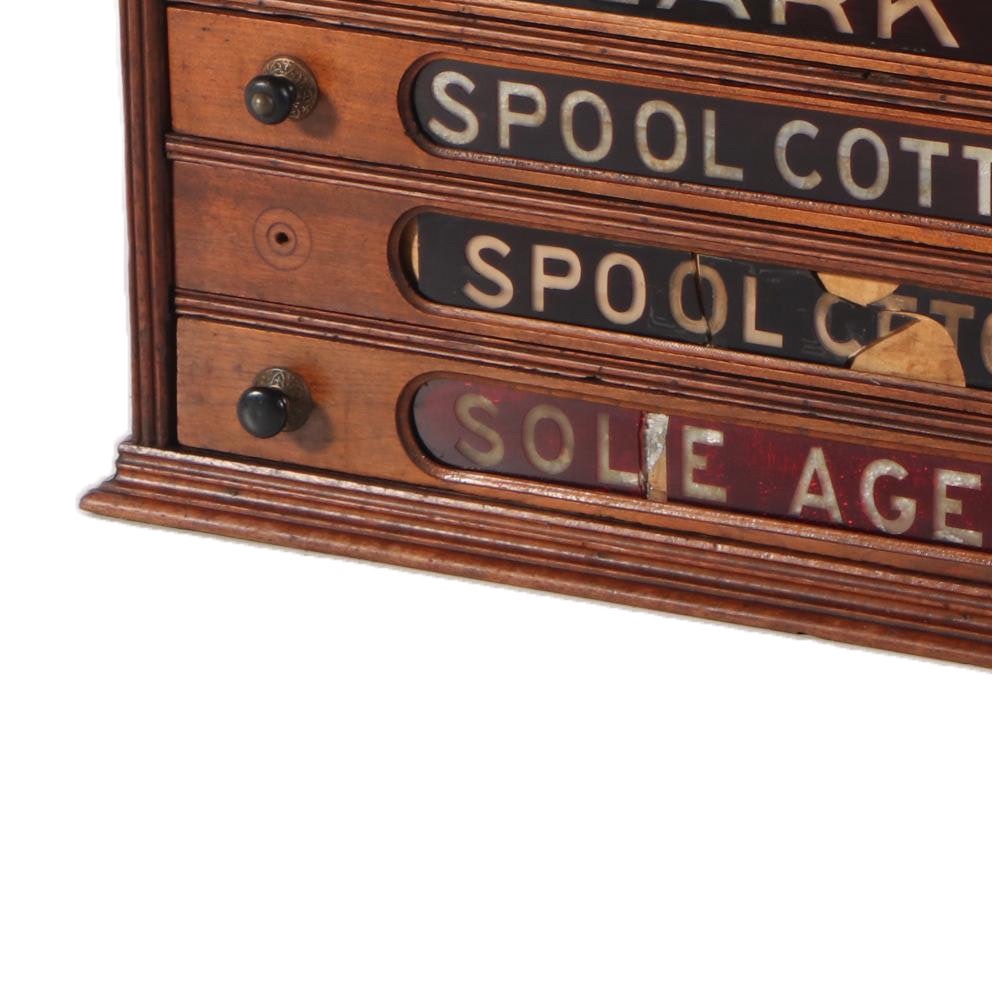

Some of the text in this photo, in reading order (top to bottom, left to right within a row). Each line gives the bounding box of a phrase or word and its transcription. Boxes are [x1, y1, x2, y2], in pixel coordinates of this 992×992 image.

[429, 70, 744, 182] SPOOL
[464, 234, 783, 349] SPOOL
[453, 393, 726, 502] SOLE
